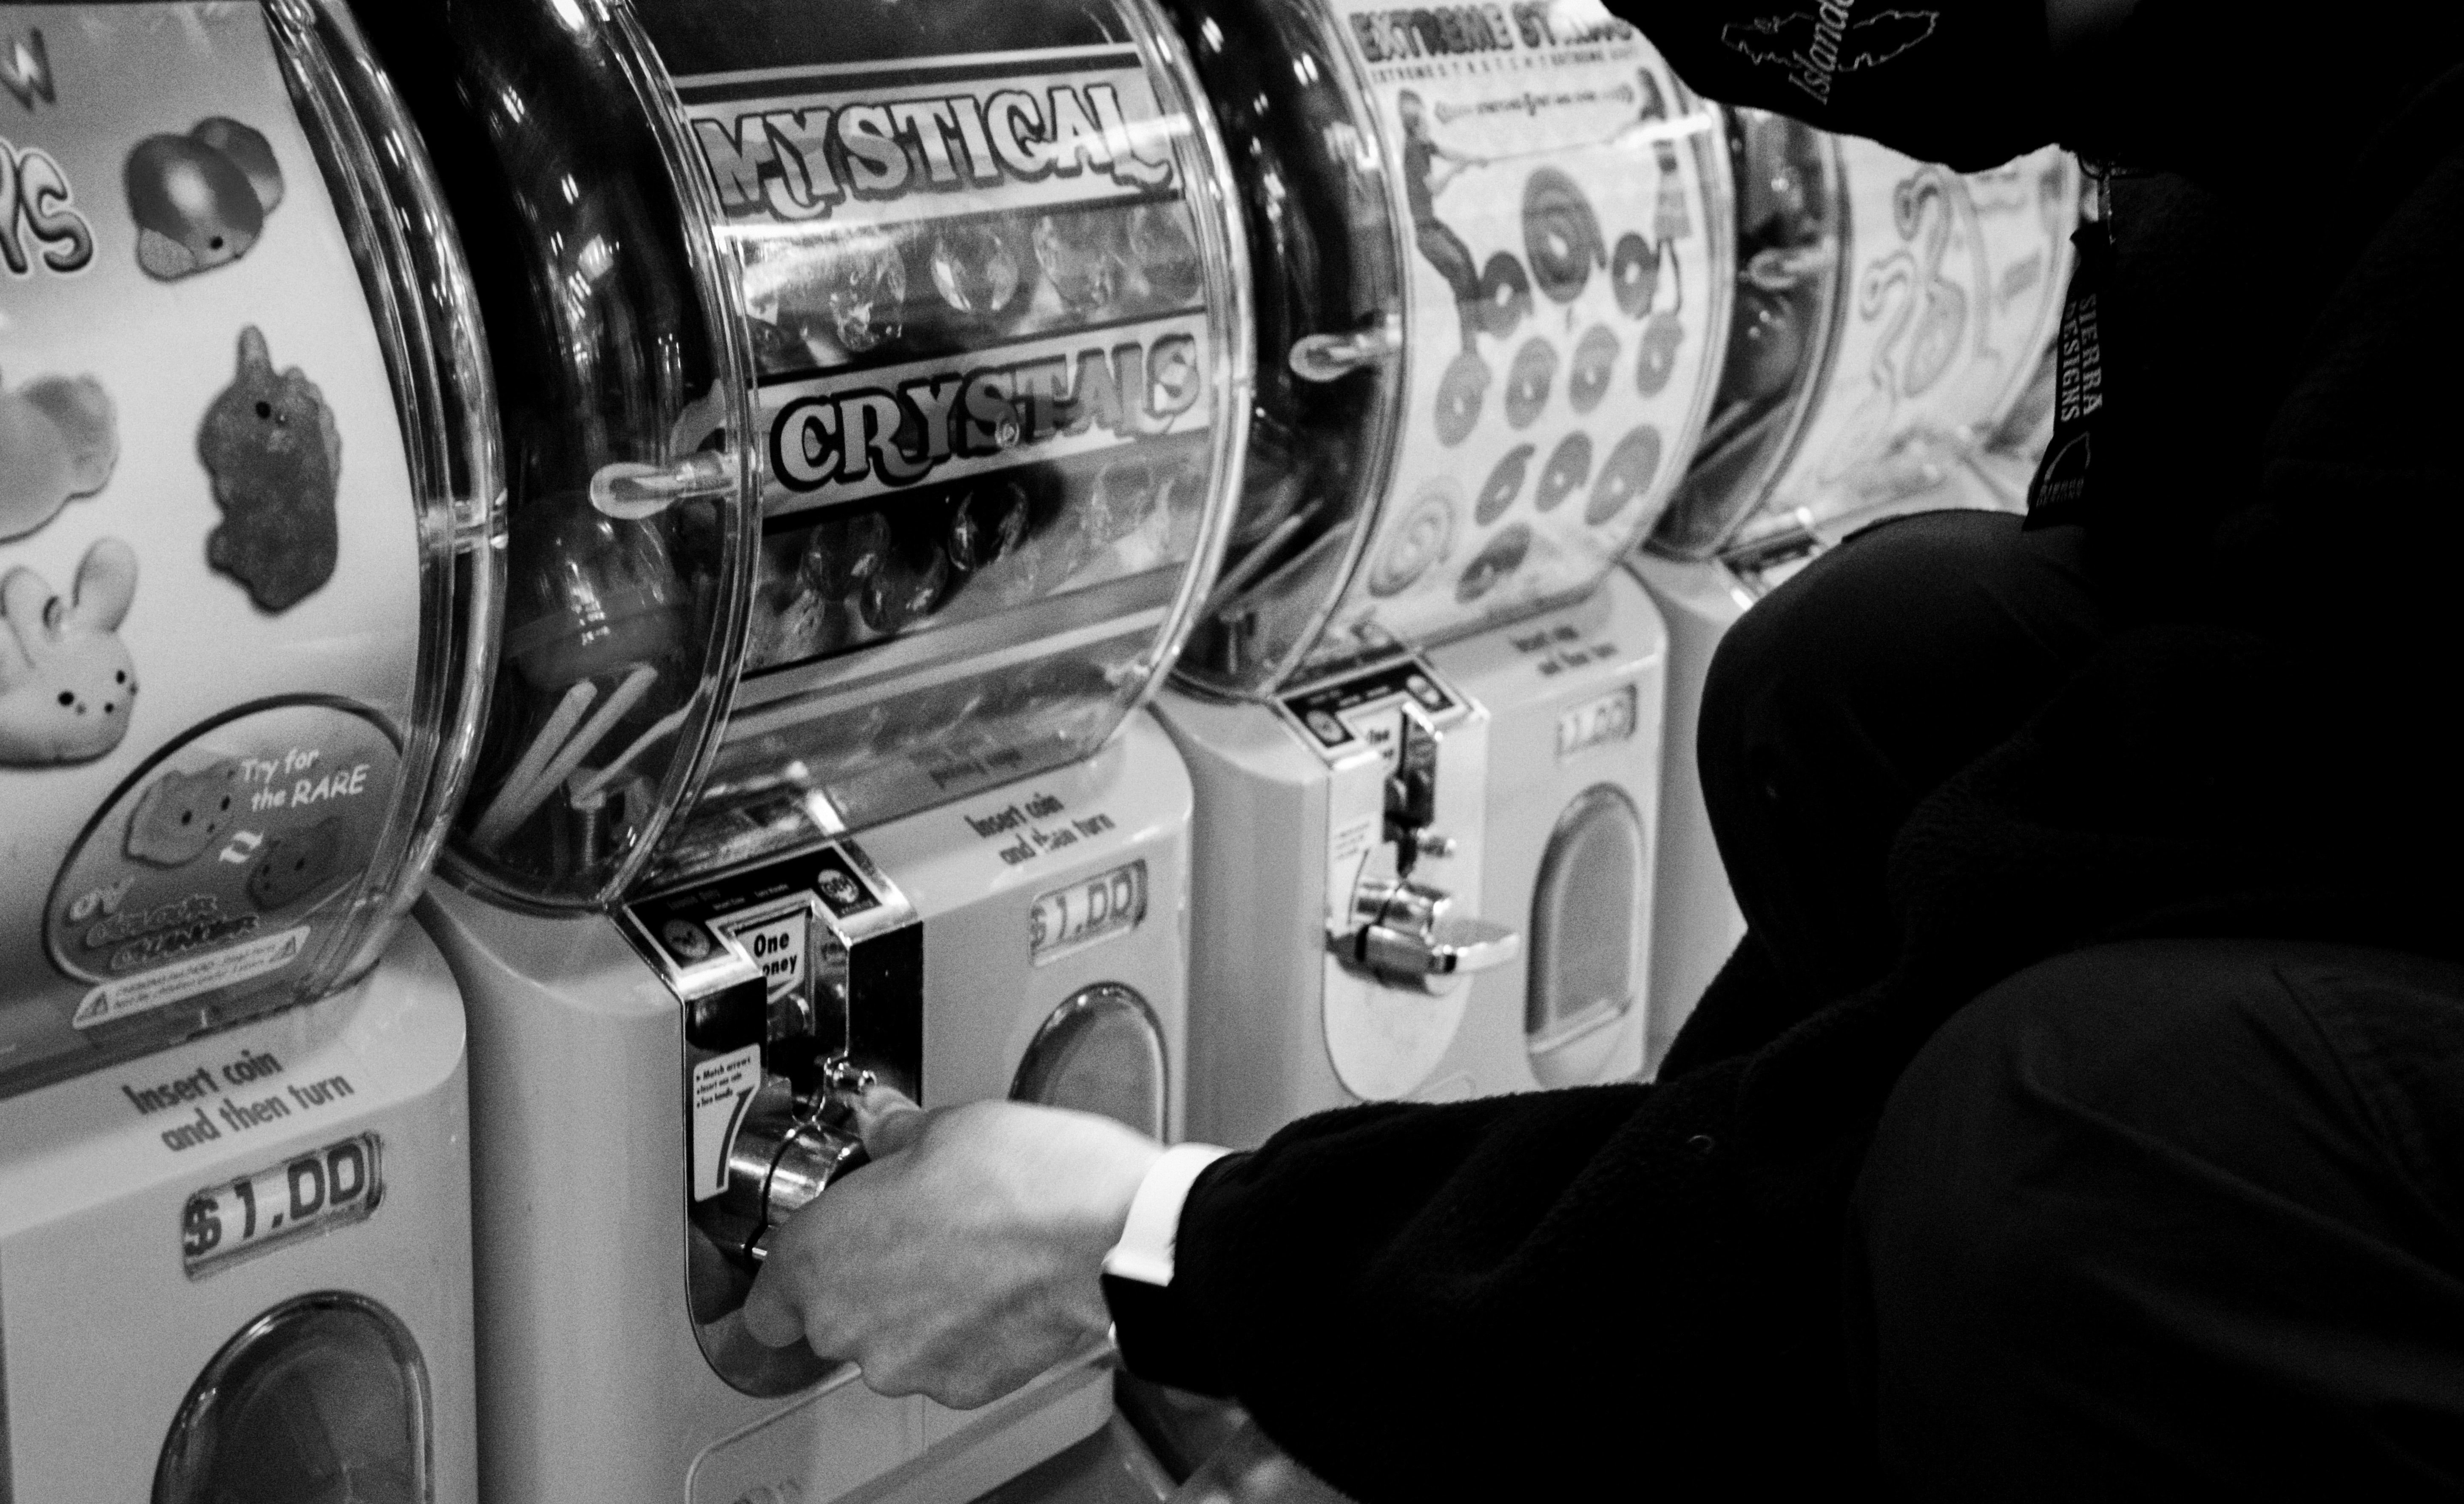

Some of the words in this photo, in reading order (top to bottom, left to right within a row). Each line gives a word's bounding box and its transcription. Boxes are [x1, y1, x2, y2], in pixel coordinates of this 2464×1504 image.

[693, 84, 1174, 222] MYSTICAL
[2061, 302, 2080, 423] DESIGNS
[2080, 293, 2103, 415] SIERRA
[770, 334, 1201, 492] CRYSTALS
[239, 758, 280, 783] Try
[283, 748, 320, 775] for
[251, 787, 285, 812] the
[291, 765, 369, 807] RARE
[964, 806, 1026, 838] Insert
[1025, 792, 1064, 818] coin
[999, 834, 1036, 865] and
[1072, 814, 1116, 837] turn
[1030, 869, 1133, 949] $1.00
[754, 932, 790, 958] One
[762, 955, 797, 976] oney
[122, 1067, 220, 1114] Insert
[222, 1048, 284, 1087] coin
[703, 1064, 725, 1080] Match
[161, 1107, 222, 1152] and
[220, 1098, 291, 1132] then
[287, 1073, 355, 1109] turn
[184, 1141, 366, 1257] $1.00
